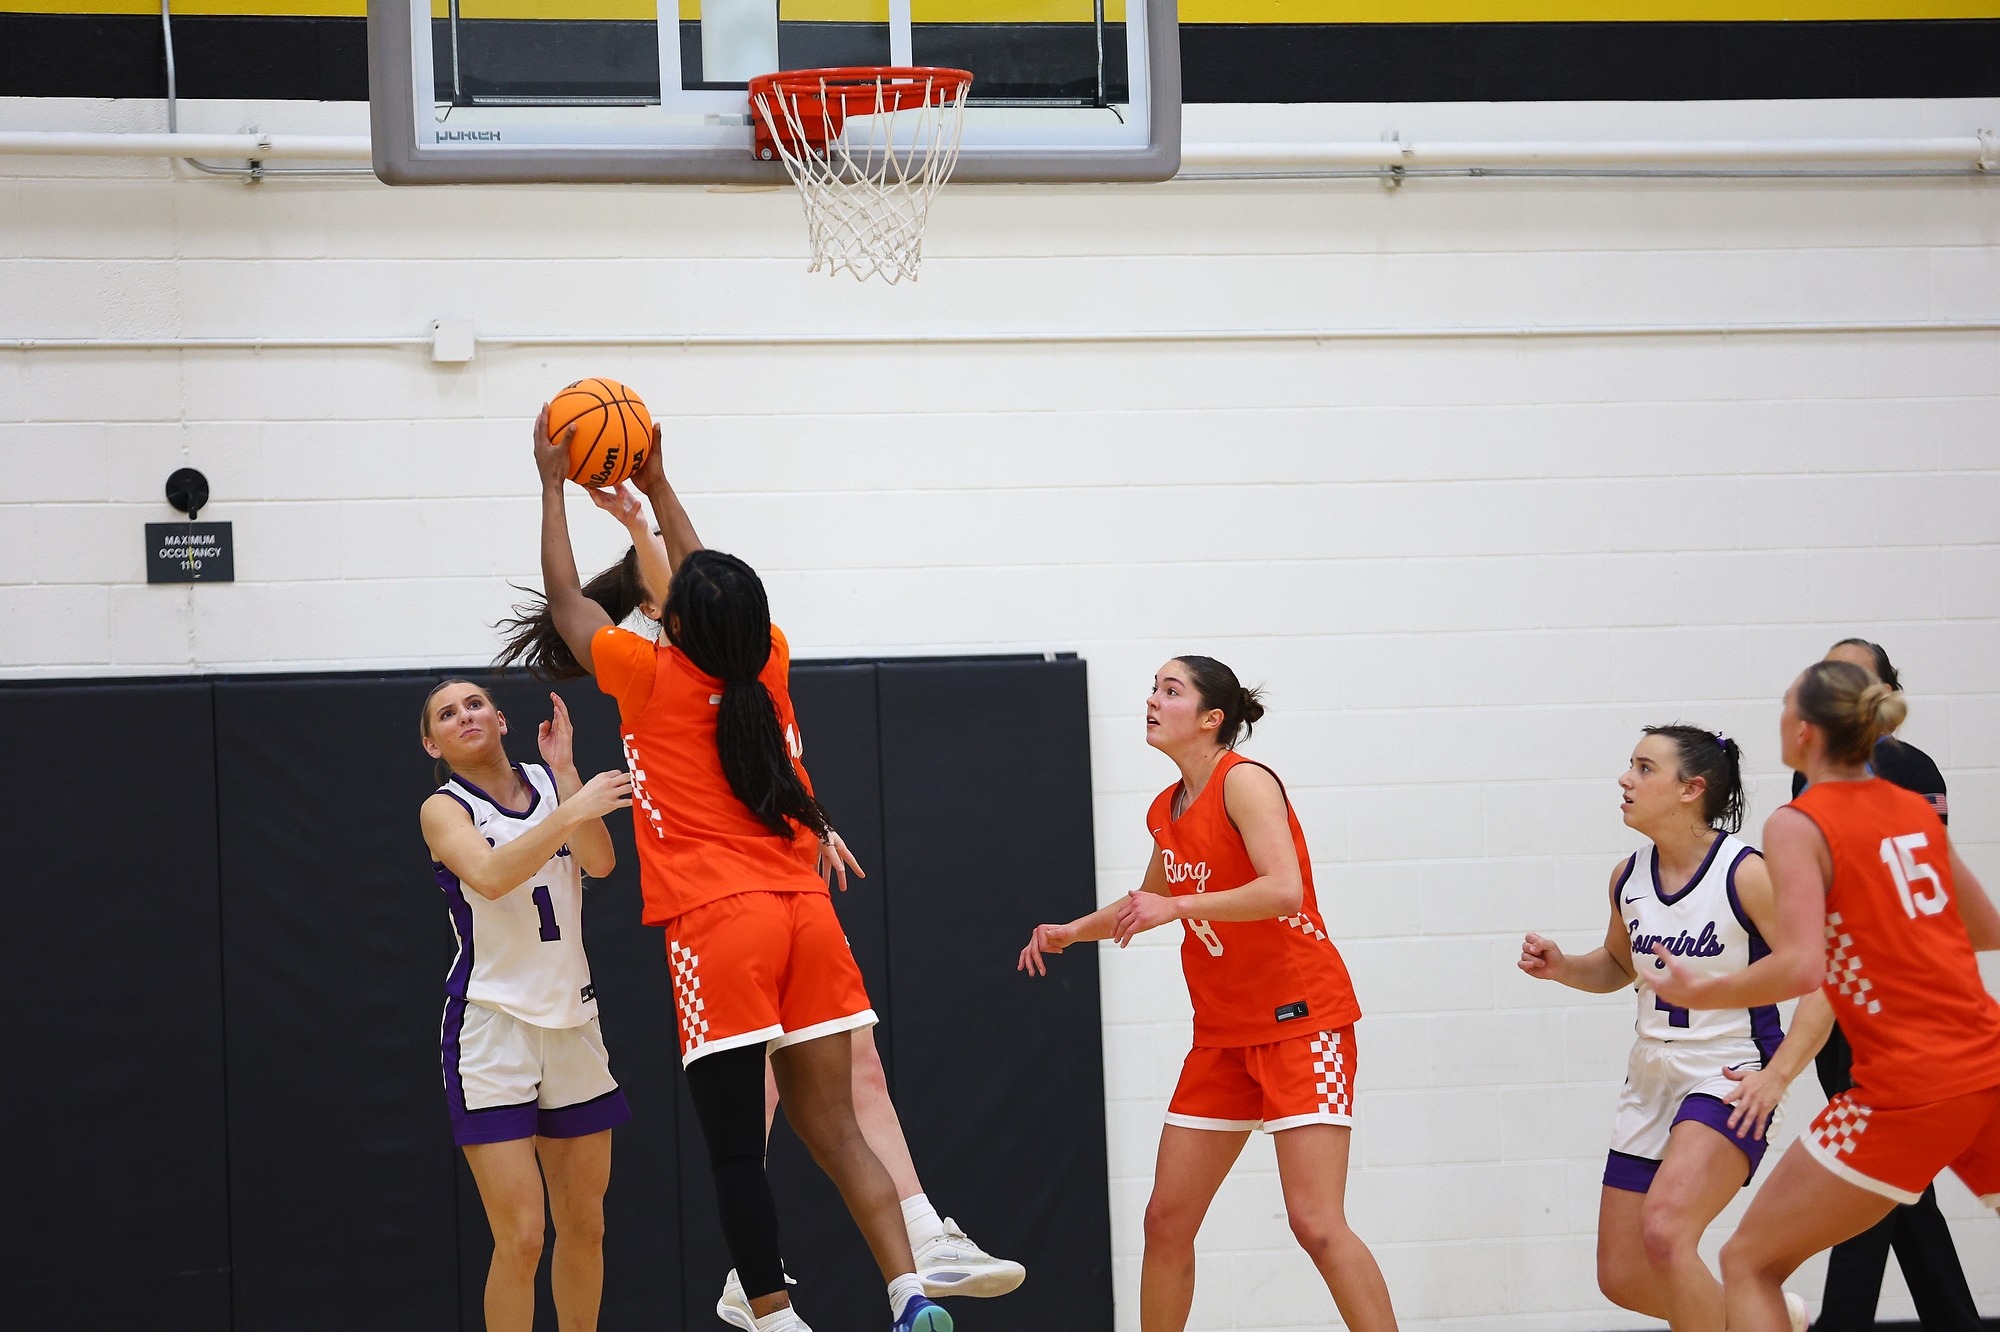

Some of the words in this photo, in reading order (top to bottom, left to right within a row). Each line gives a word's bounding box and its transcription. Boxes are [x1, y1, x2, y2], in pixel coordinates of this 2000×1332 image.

[164, 534, 216, 546] MAXIMUM
[180, 560, 203, 571] 1110
[1161, 848, 1212, 894] Burg
[1879, 831, 1949, 920] 15
[531, 884, 562, 942] 1
